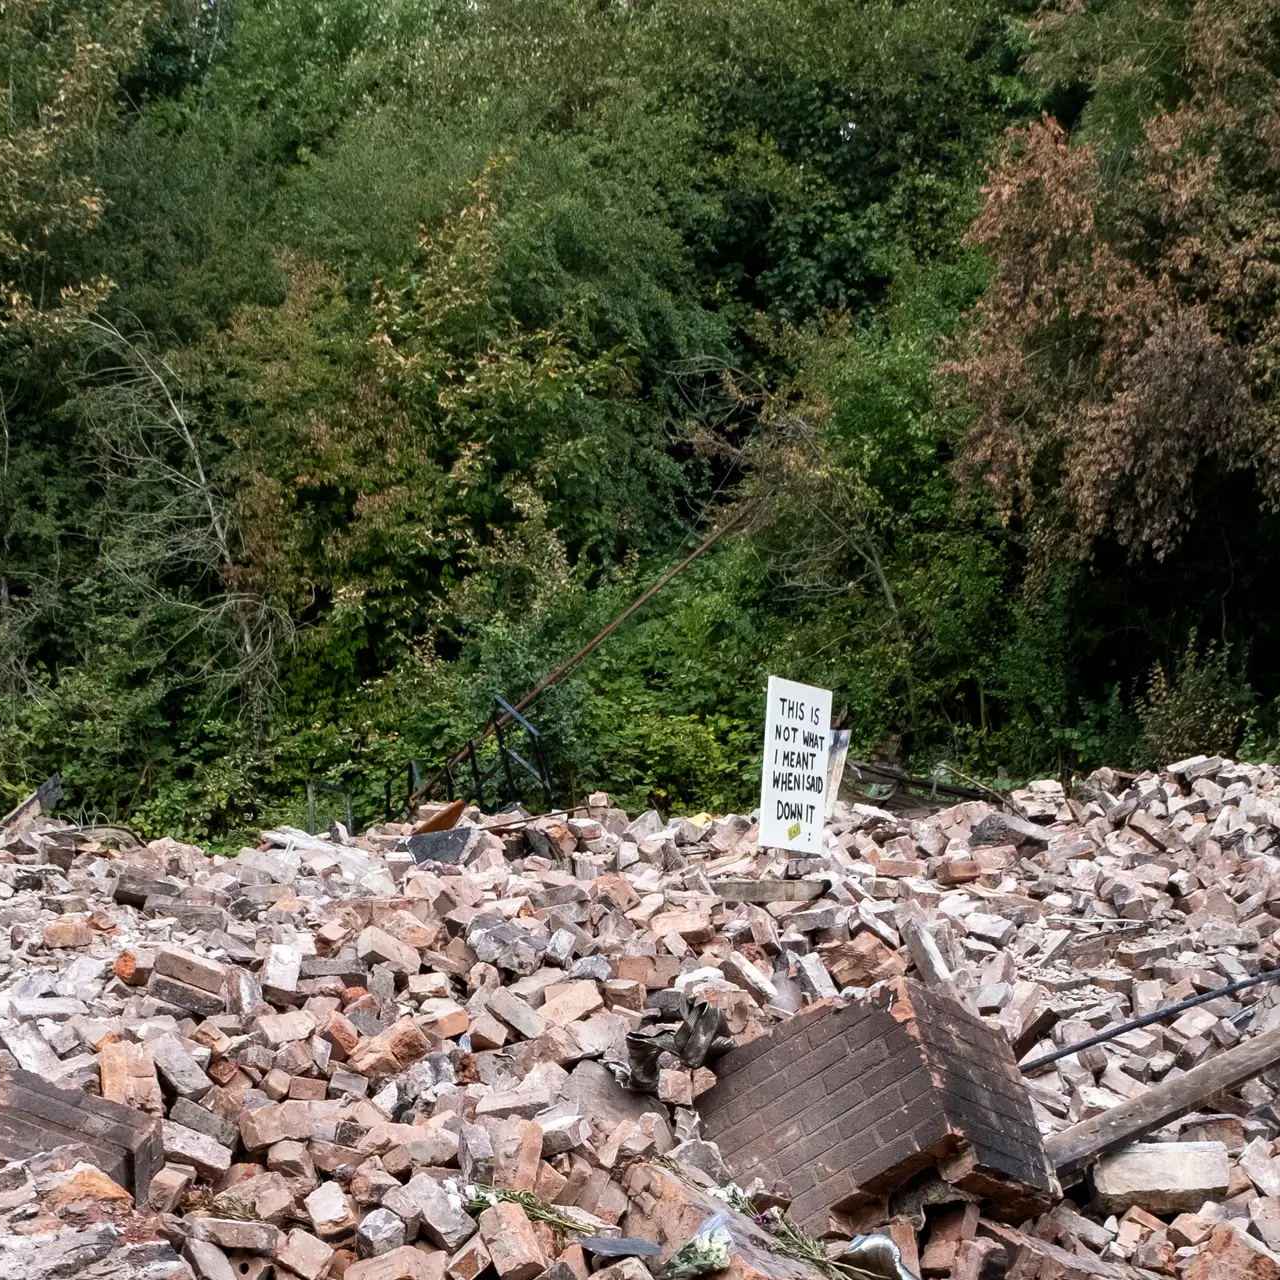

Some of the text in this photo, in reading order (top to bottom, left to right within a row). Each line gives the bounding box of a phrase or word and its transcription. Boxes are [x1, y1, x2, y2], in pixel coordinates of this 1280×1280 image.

[779, 697, 820, 726] THIS IS
[775, 724, 825, 751] NOT WHAT
[774, 749, 816, 771] I MEANT
[772, 770, 801, 792] WHEN
[806, 774, 823, 794] SAID
[776, 800, 816, 824] DOWN IT
